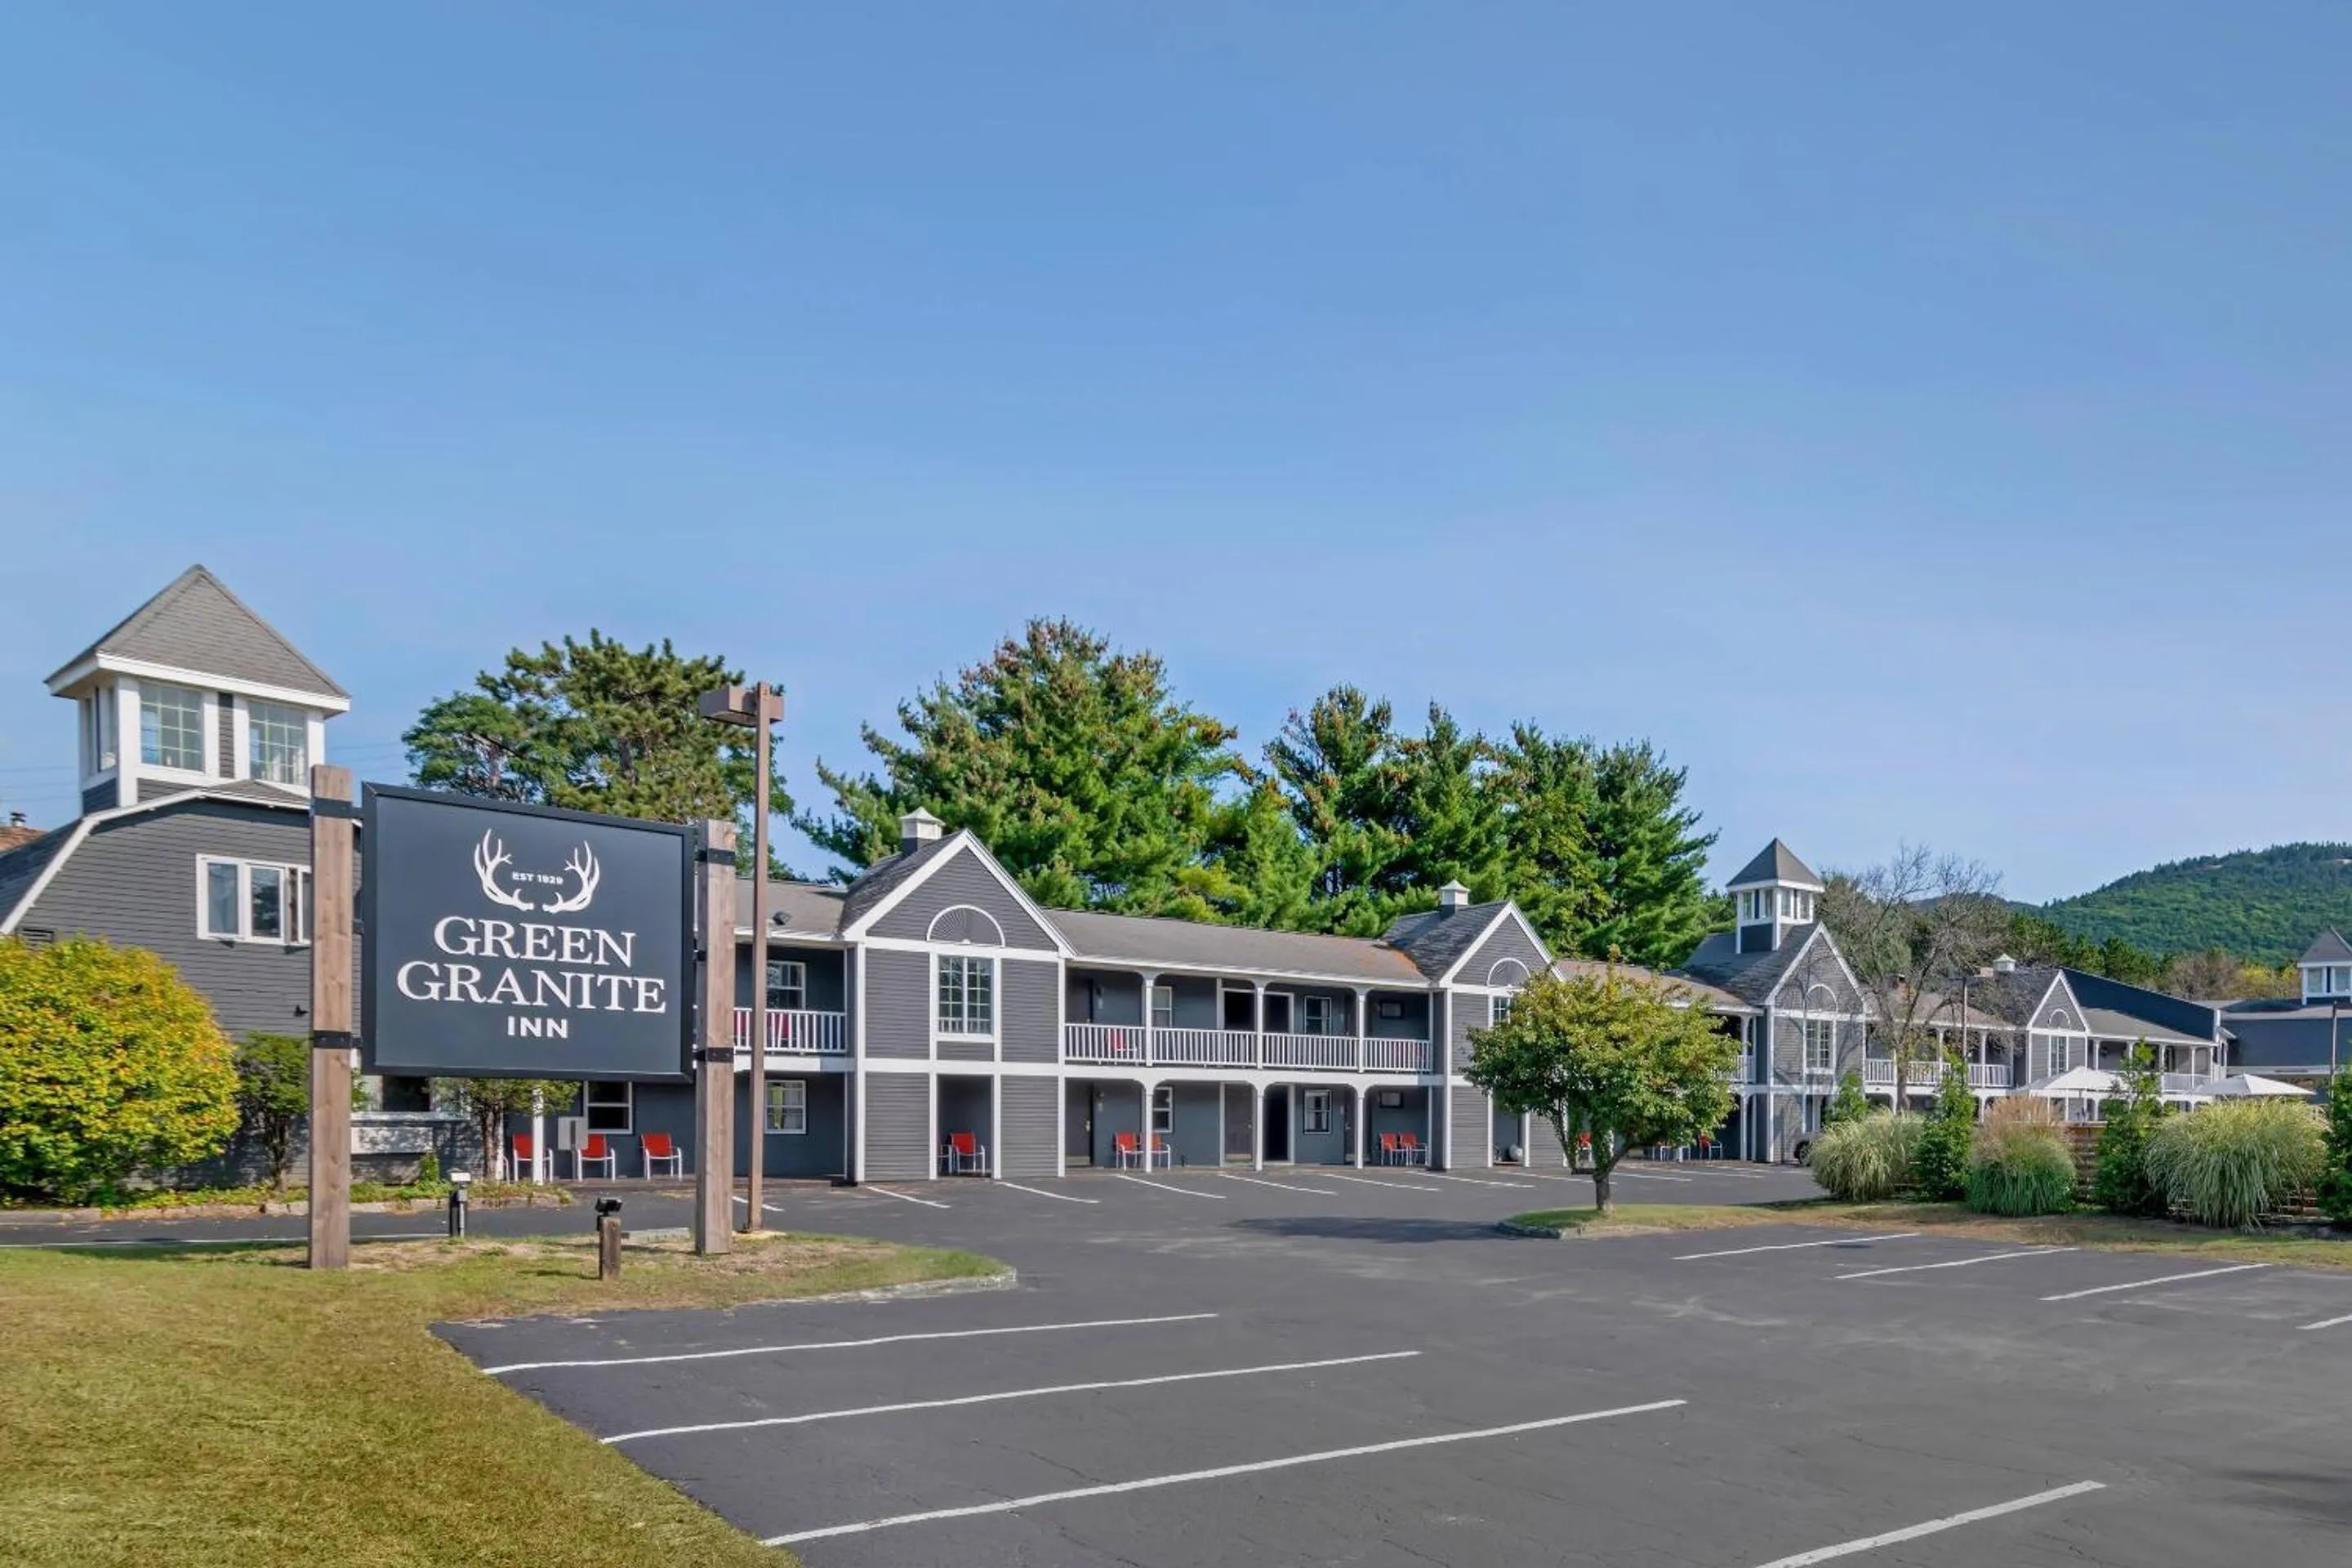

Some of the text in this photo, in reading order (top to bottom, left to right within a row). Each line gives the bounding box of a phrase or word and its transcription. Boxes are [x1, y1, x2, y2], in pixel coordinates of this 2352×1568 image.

[511, 871, 535, 882] EST
[434, 915, 636, 968] GREEN
[396, 960, 666, 1013] GRANITE
[507, 1015, 568, 1039] INN
